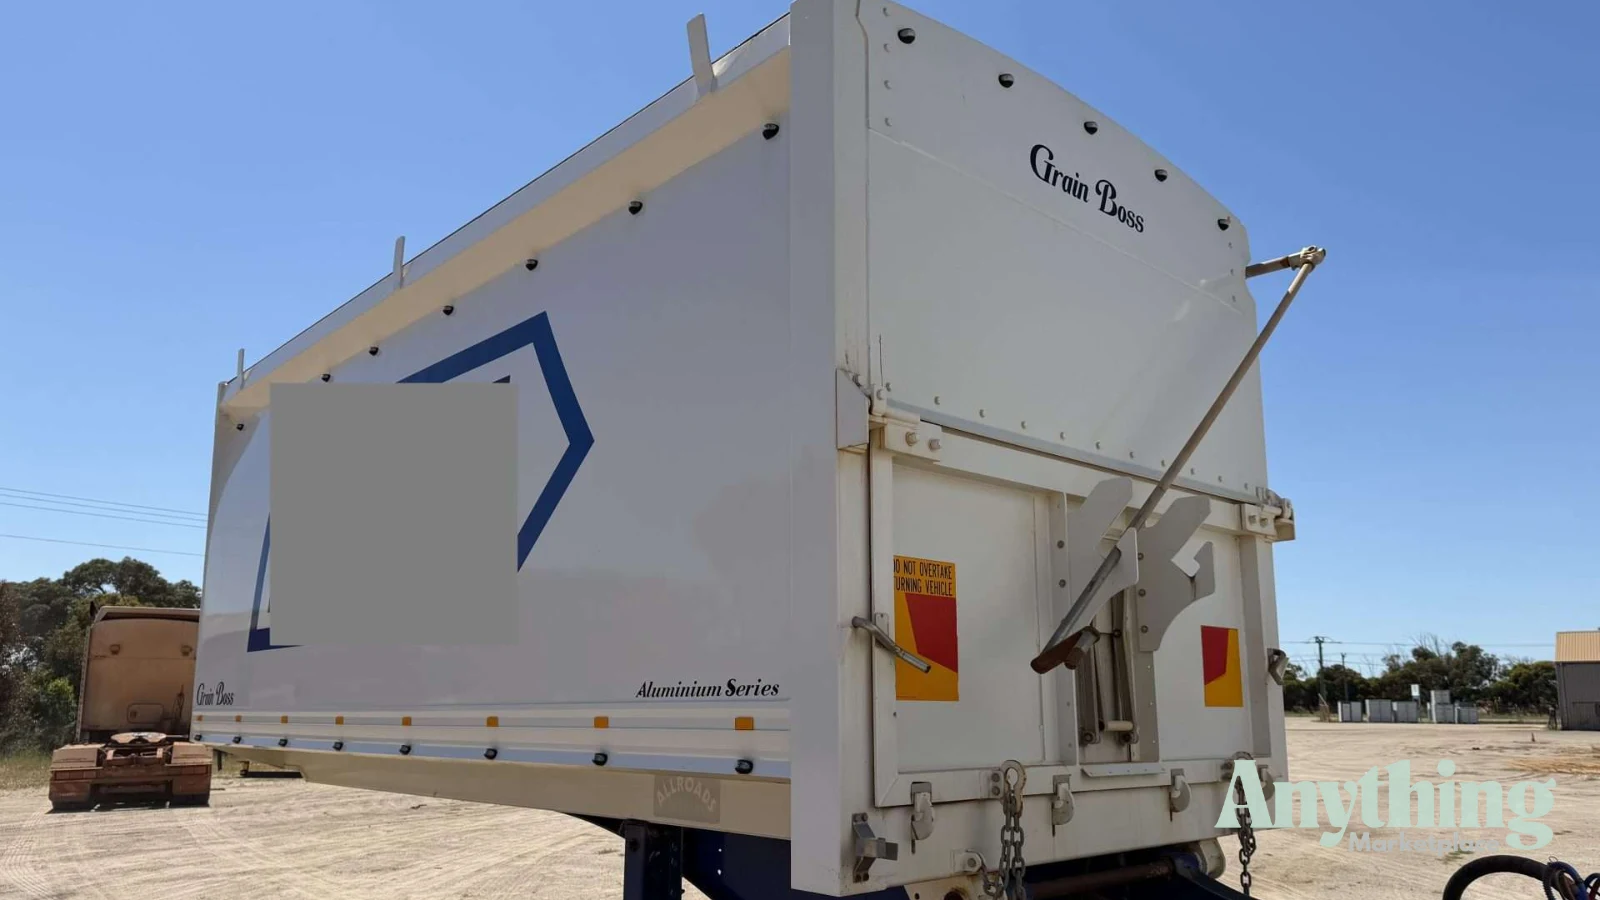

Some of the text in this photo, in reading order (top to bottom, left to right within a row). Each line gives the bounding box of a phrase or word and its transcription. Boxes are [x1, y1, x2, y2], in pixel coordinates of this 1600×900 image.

[1030, 144, 1144, 233] Grain Boss
[903, 559, 916, 576] NOT
[919, 561, 953, 580] OVERTAKE
[925, 579, 953, 597] VEHICLE
[216, 681, 235, 706] Boss
[635, 678, 780, 698] Aluminium Series
[656, 776, 717, 813] ALLROADS
